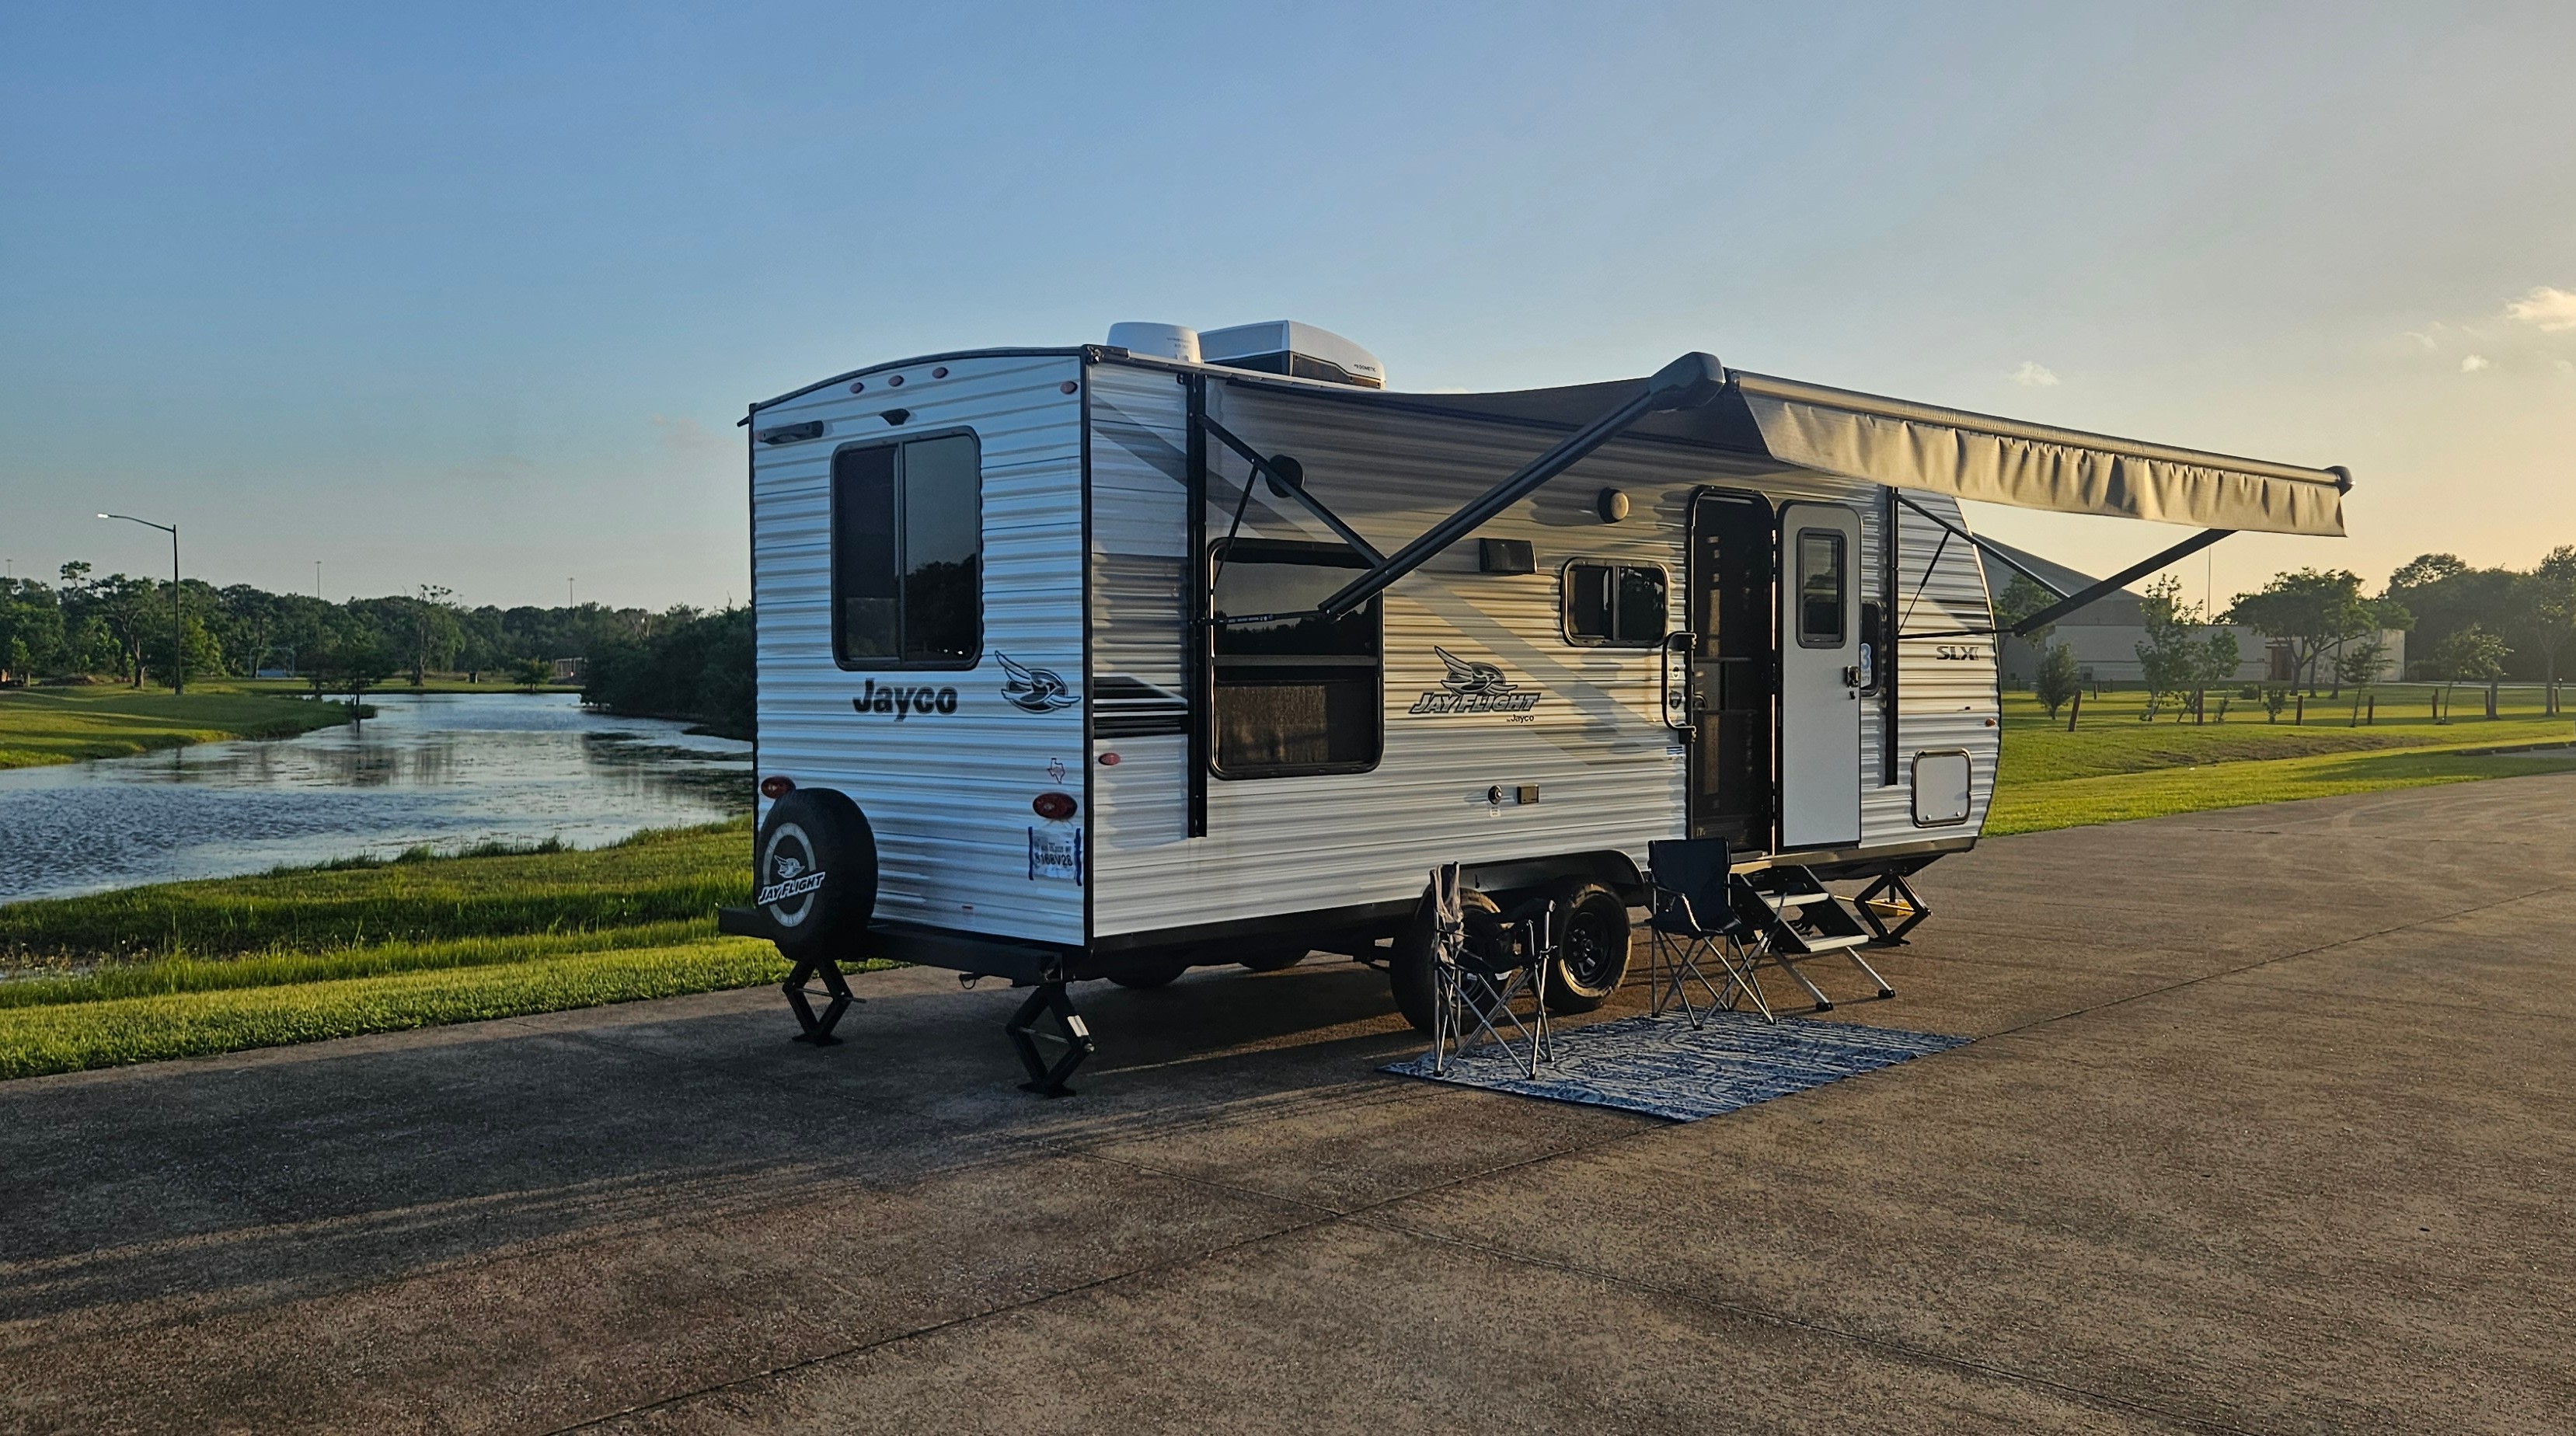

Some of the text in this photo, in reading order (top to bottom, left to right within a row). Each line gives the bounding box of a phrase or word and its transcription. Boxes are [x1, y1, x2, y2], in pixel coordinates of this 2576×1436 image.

[1936, 646, 1979, 660] SLX
[852, 678, 957, 722] Jayco
[1511, 714, 1535, 723] Jayco
